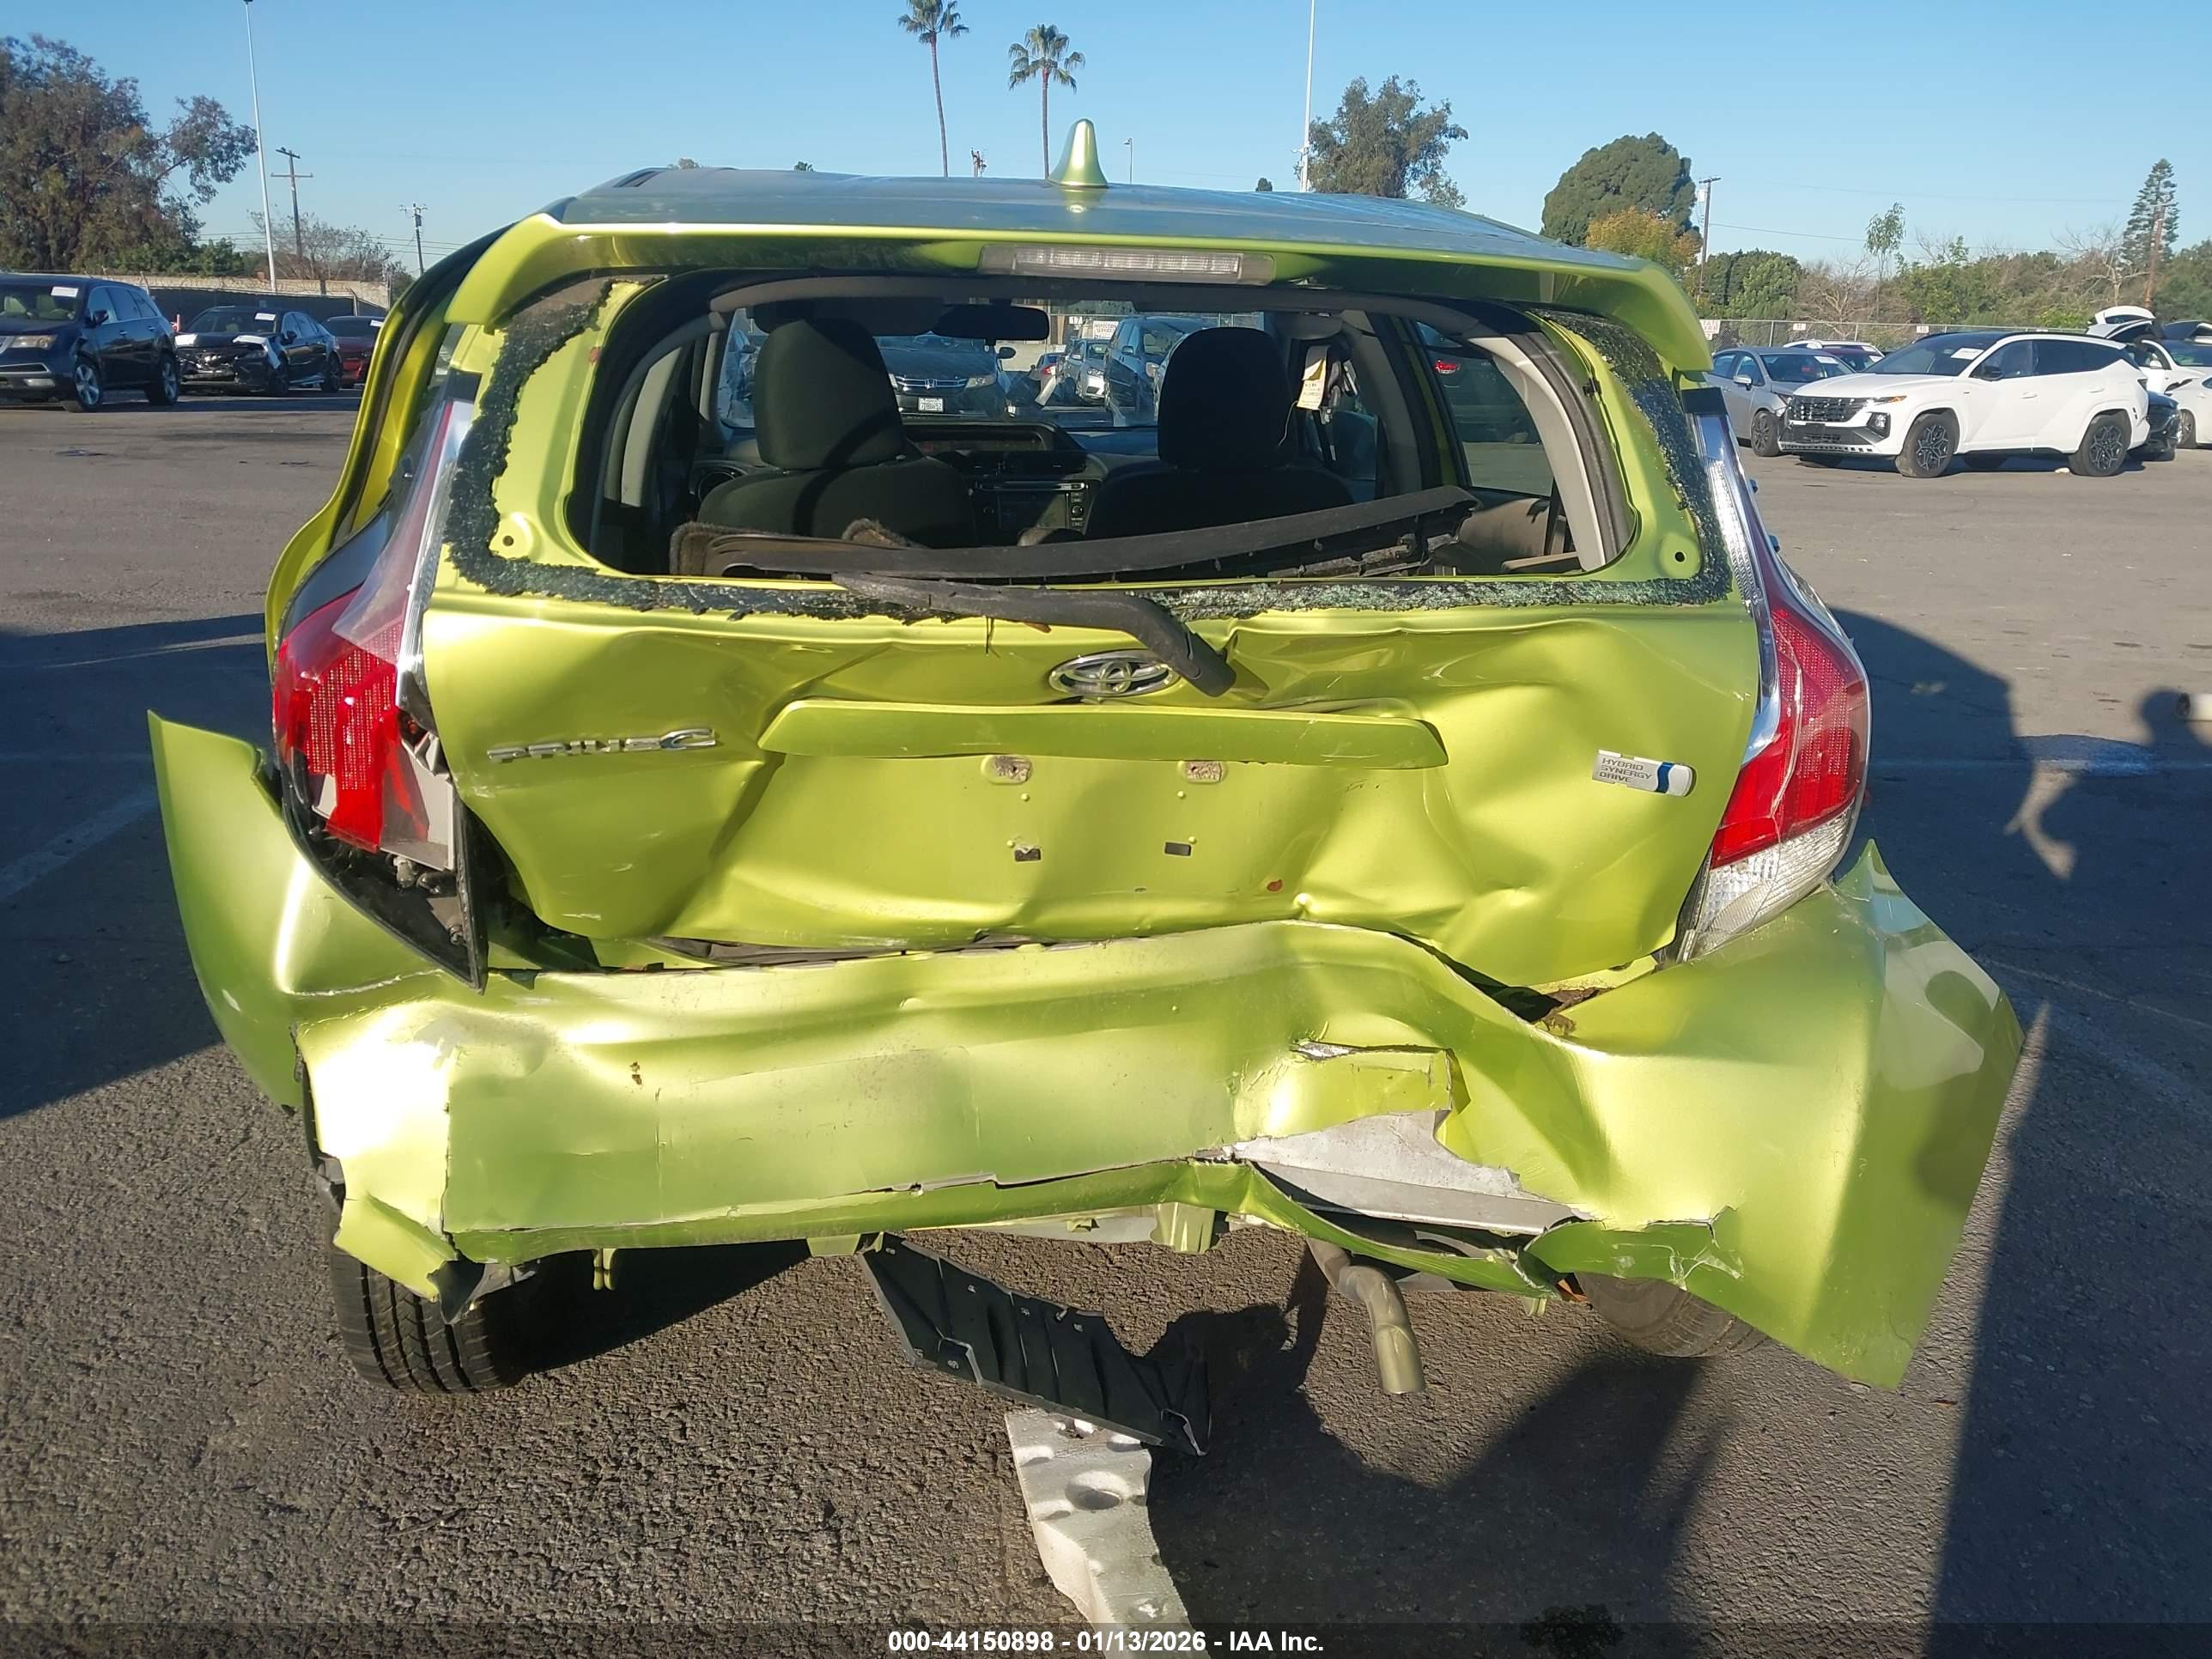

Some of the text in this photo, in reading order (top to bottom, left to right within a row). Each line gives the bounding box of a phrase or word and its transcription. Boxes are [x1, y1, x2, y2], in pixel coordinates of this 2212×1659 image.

[1601, 757, 1644, 771] HYBRID
[1599, 771, 1632, 783] DRIVE
[1601, 764, 1652, 780] SYNERGY
